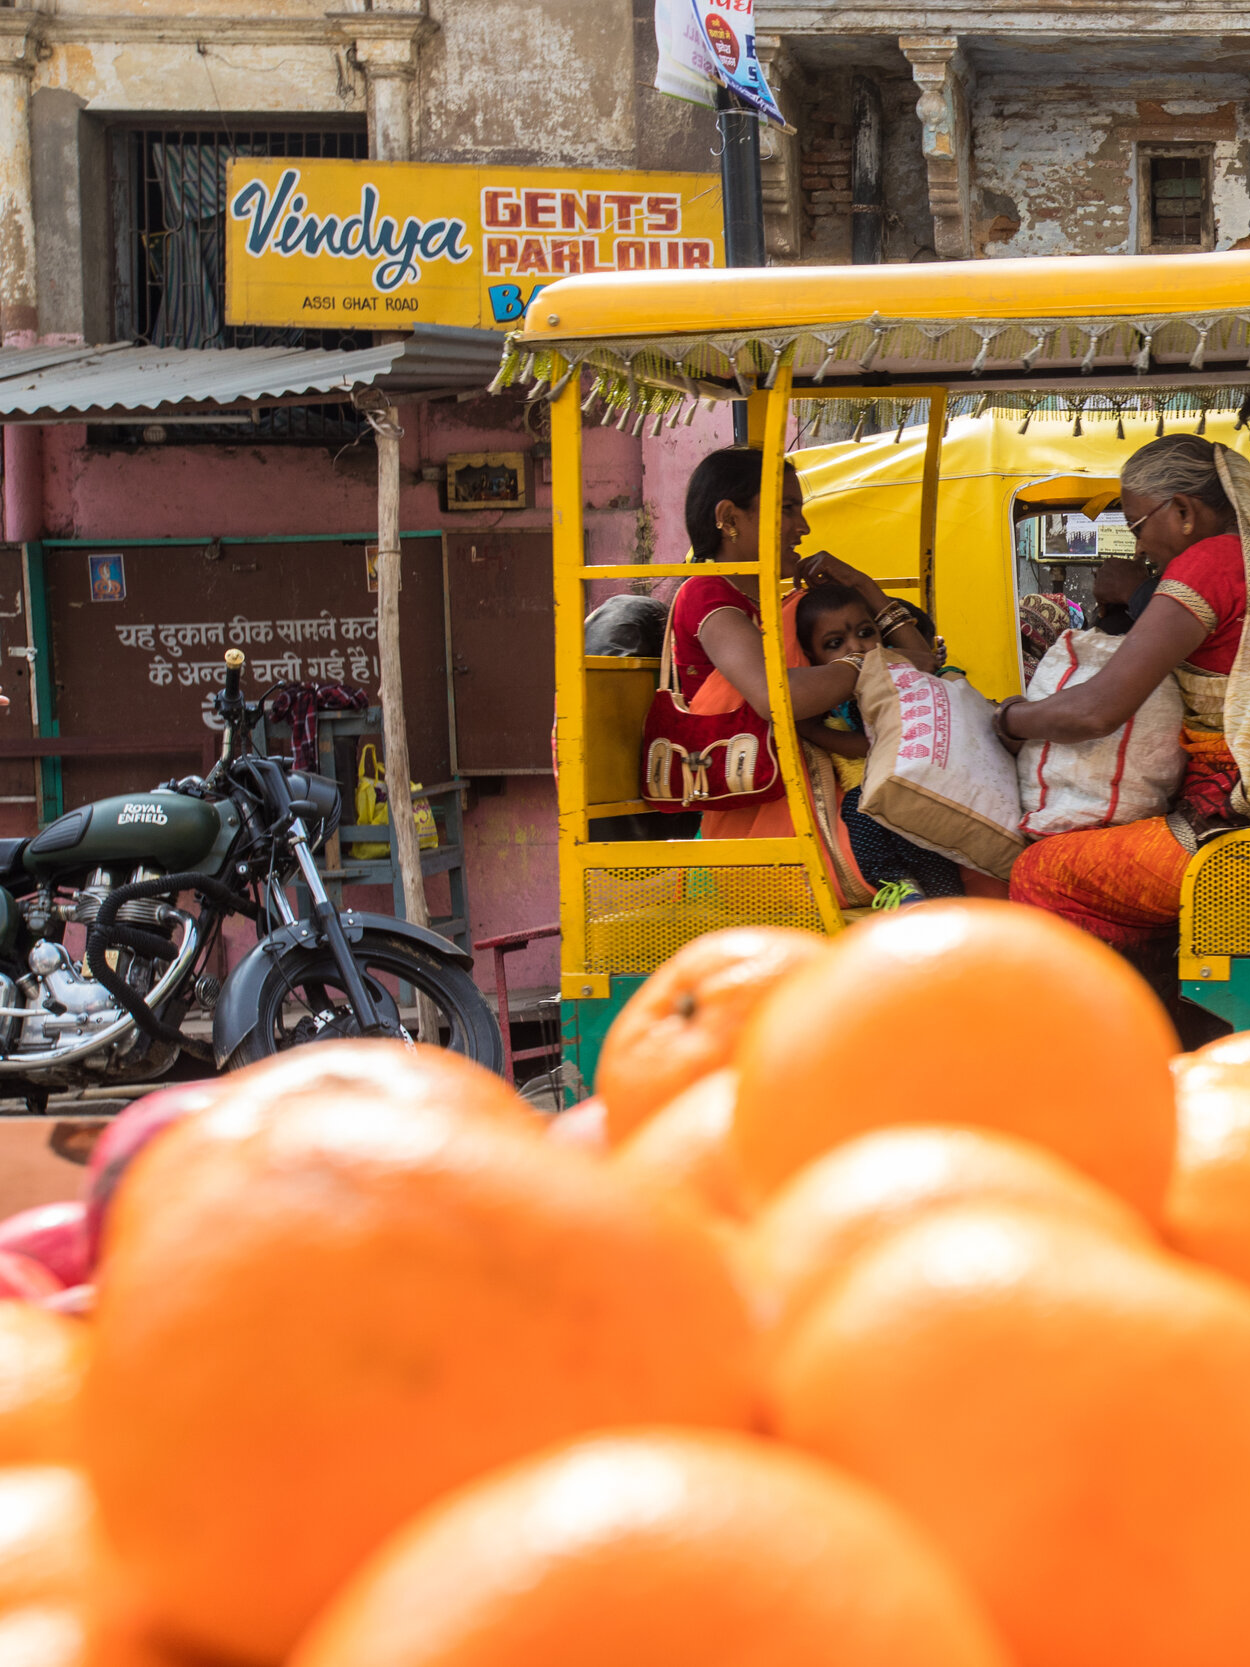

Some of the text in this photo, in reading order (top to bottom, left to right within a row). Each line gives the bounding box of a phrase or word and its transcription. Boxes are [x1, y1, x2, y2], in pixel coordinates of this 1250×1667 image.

[482, 188, 681, 234] GENTS
[231, 169, 472, 292] Vindya
[483, 235, 714, 275] PARLOUR
[302, 297, 419, 311] ASSI GHAT ROAD
[115, 624, 155, 650] यह
[158, 622, 225, 657] दुकान
[228, 615, 273, 645] ठीक
[276, 610, 336, 644] सामने
[149, 654, 173, 686] के
[252, 651, 302, 683] चली
[308, 649, 345, 684] गई
[117, 813, 168, 825] ENFIELD
[123, 803, 164, 814] ROYAL
